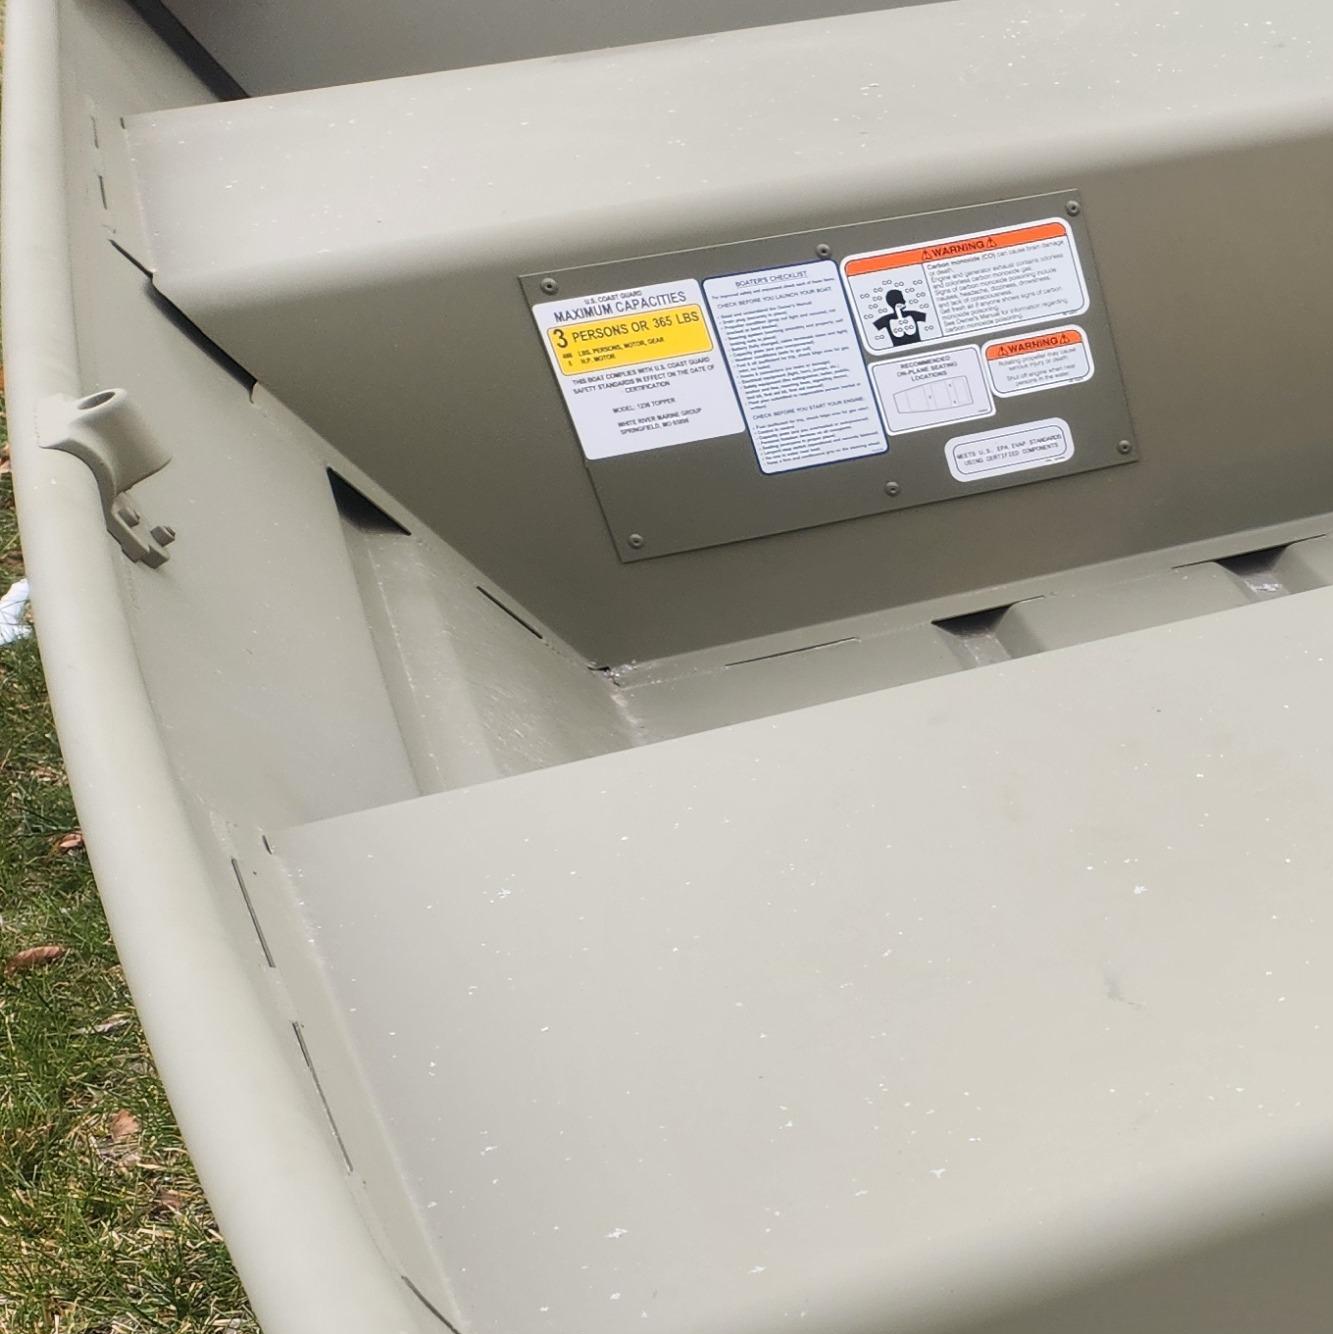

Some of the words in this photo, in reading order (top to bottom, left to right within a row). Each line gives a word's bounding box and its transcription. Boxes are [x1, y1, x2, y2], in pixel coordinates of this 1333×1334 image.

[932, 241, 985, 256] WARNING
[770, 271, 807, 281] CHECKLIST
[598, 294, 619, 302] COAST
[621, 291, 643, 299] GUARD
[554, 304, 614, 323] MAXIMUM
[619, 291, 688, 312] CAPACITIES
[552, 328, 569, 348] 3
[572, 324, 630, 342] PERSONS
[631, 320, 650, 332] OR
[652, 316, 673, 328] 365
[676, 311, 700, 324] LBS
[1009, 337, 1058, 353] WARNING
[606, 370, 637, 379] COMPLIES
[689, 357, 710, 365] GUARD
[901, 356, 951, 368] RECOMMENDED
[897, 367, 929, 377] ON-PLANE
[931, 362, 958, 370] SEATING
[912, 371, 948, 381] LOCATIONS
[574, 386, 596, 394] SAFETY
[598, 379, 635, 390] STANDARDS
[643, 373, 666, 382] EFFECT
[625, 381, 671, 393] CERTIFICATION
[652, 398, 676, 406] TOPPER
[657, 412, 680, 420] MARINE
[681, 408, 702, 416] GROUP
